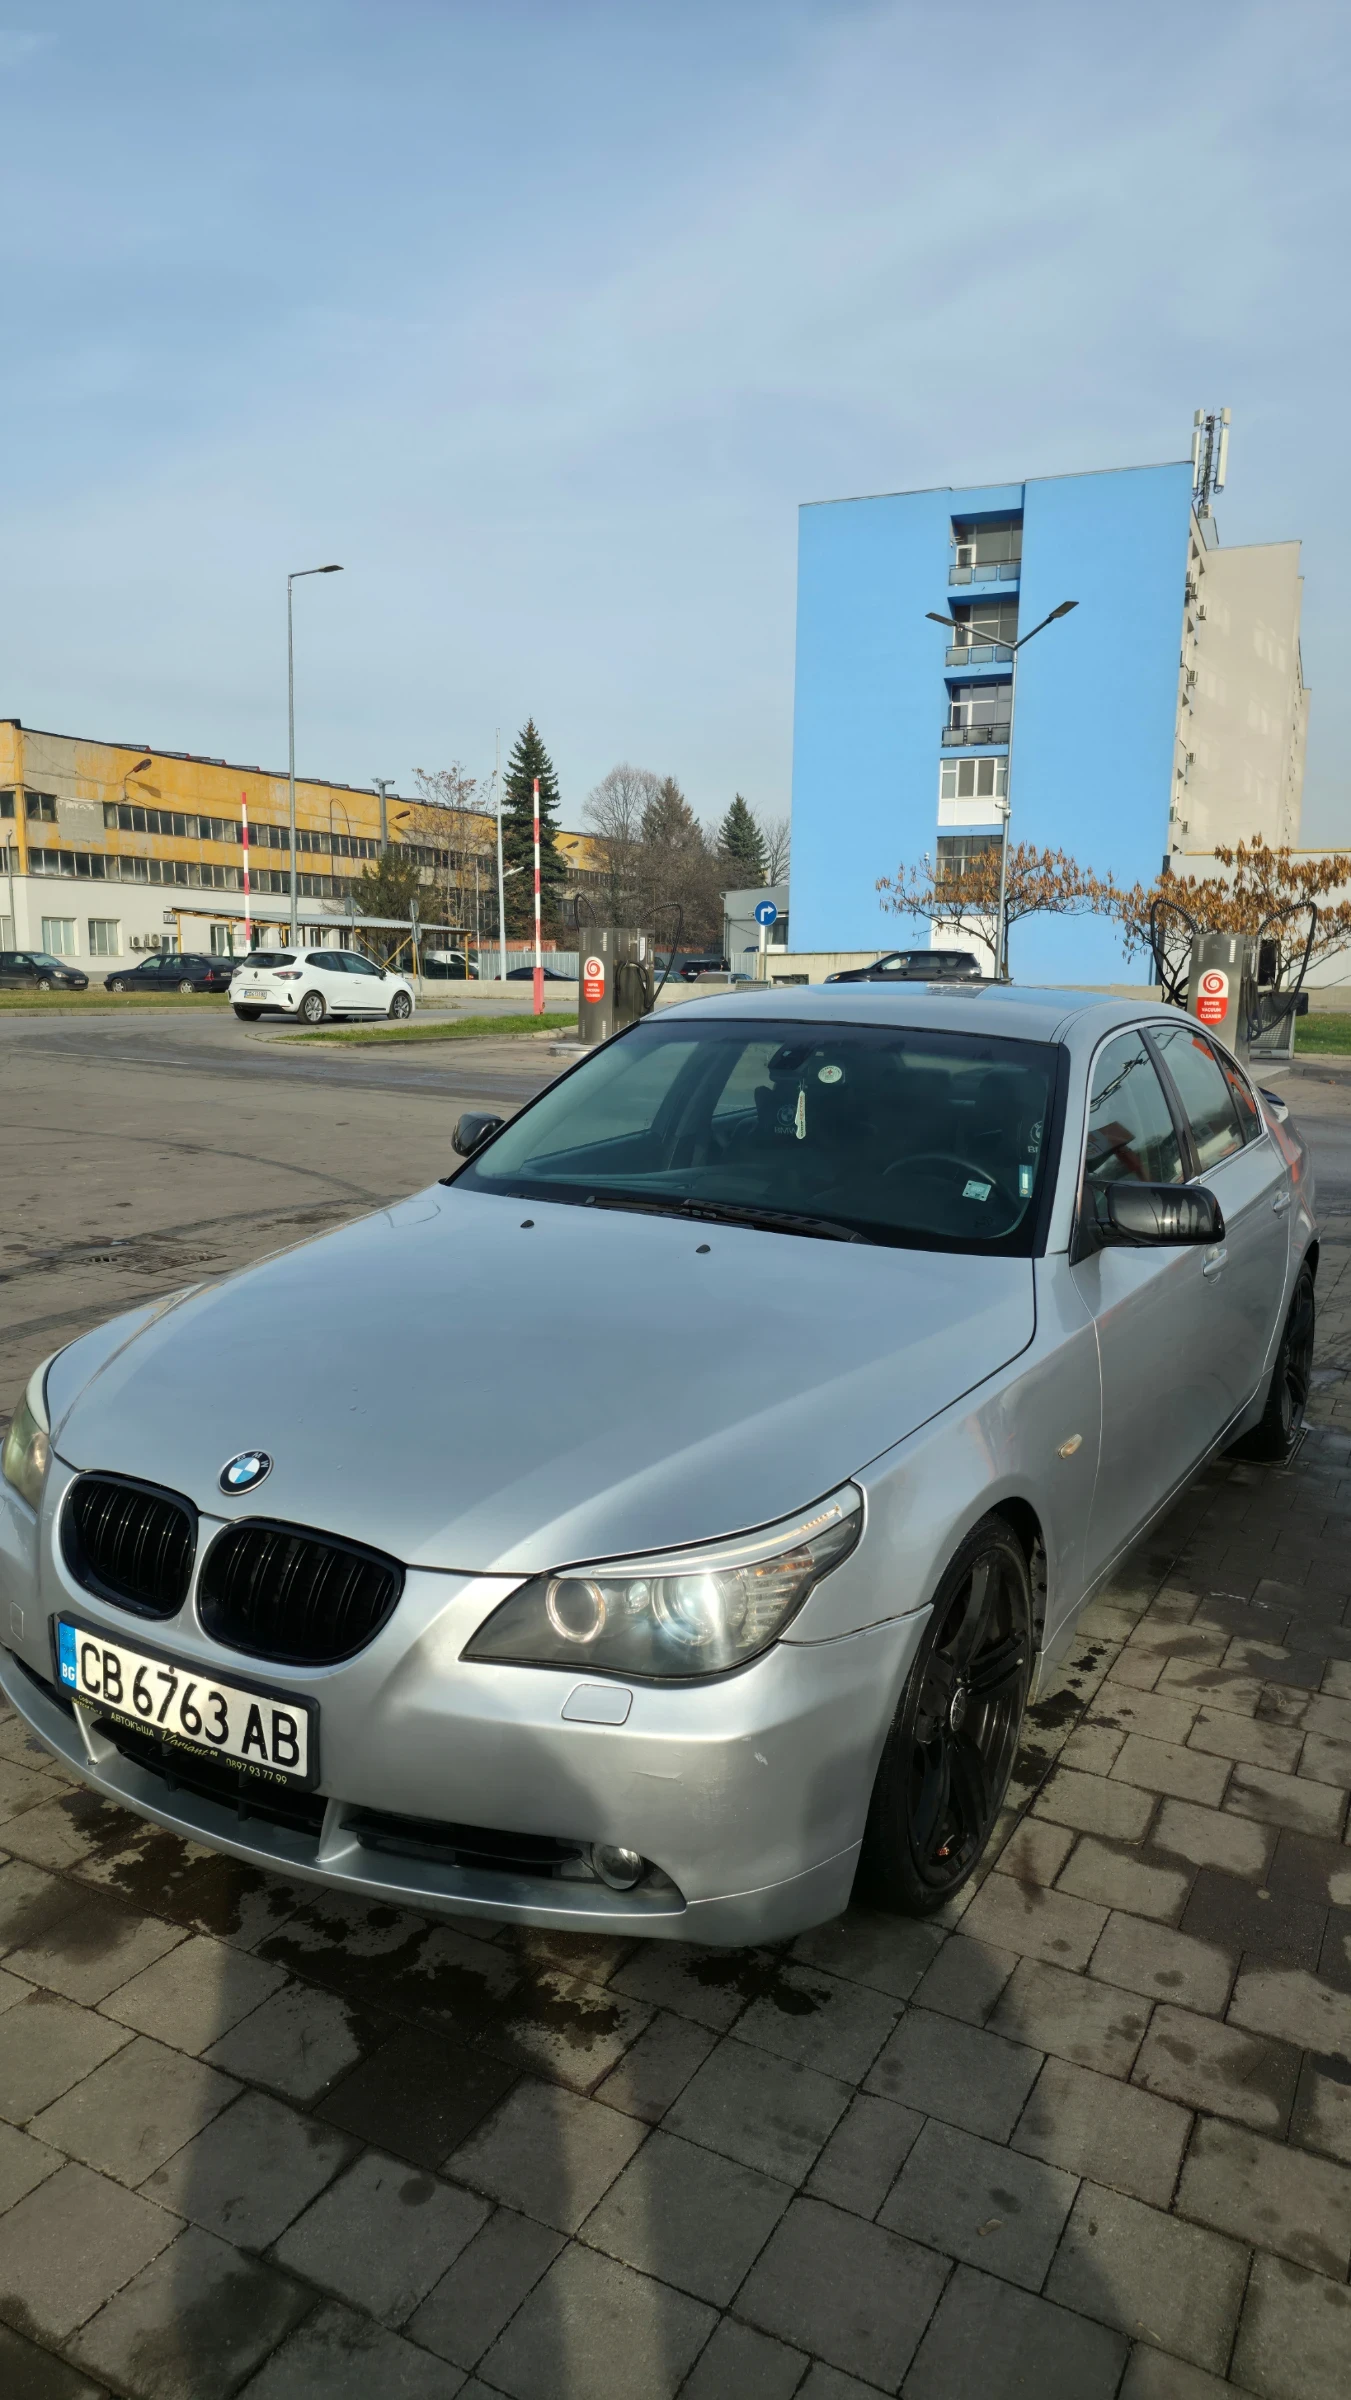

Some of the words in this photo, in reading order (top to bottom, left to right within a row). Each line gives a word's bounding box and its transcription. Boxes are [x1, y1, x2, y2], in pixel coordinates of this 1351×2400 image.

[236, 1452, 270, 1469] BMW
[61, 1662, 76, 1681] BG
[80, 1641, 124, 1705] CB
[132, 1664, 229, 1746] 6763
[241, 1702, 300, 1768] AB
[110, 1712, 155, 1738] АВТОКЪША
[161, 1729, 209, 1757] Variant
[225, 1757, 248, 1772] 0897
[249, 1765, 261, 1777] 93
[262, 1769, 274, 1781] 77
[275, 1773, 288, 1785] 99
